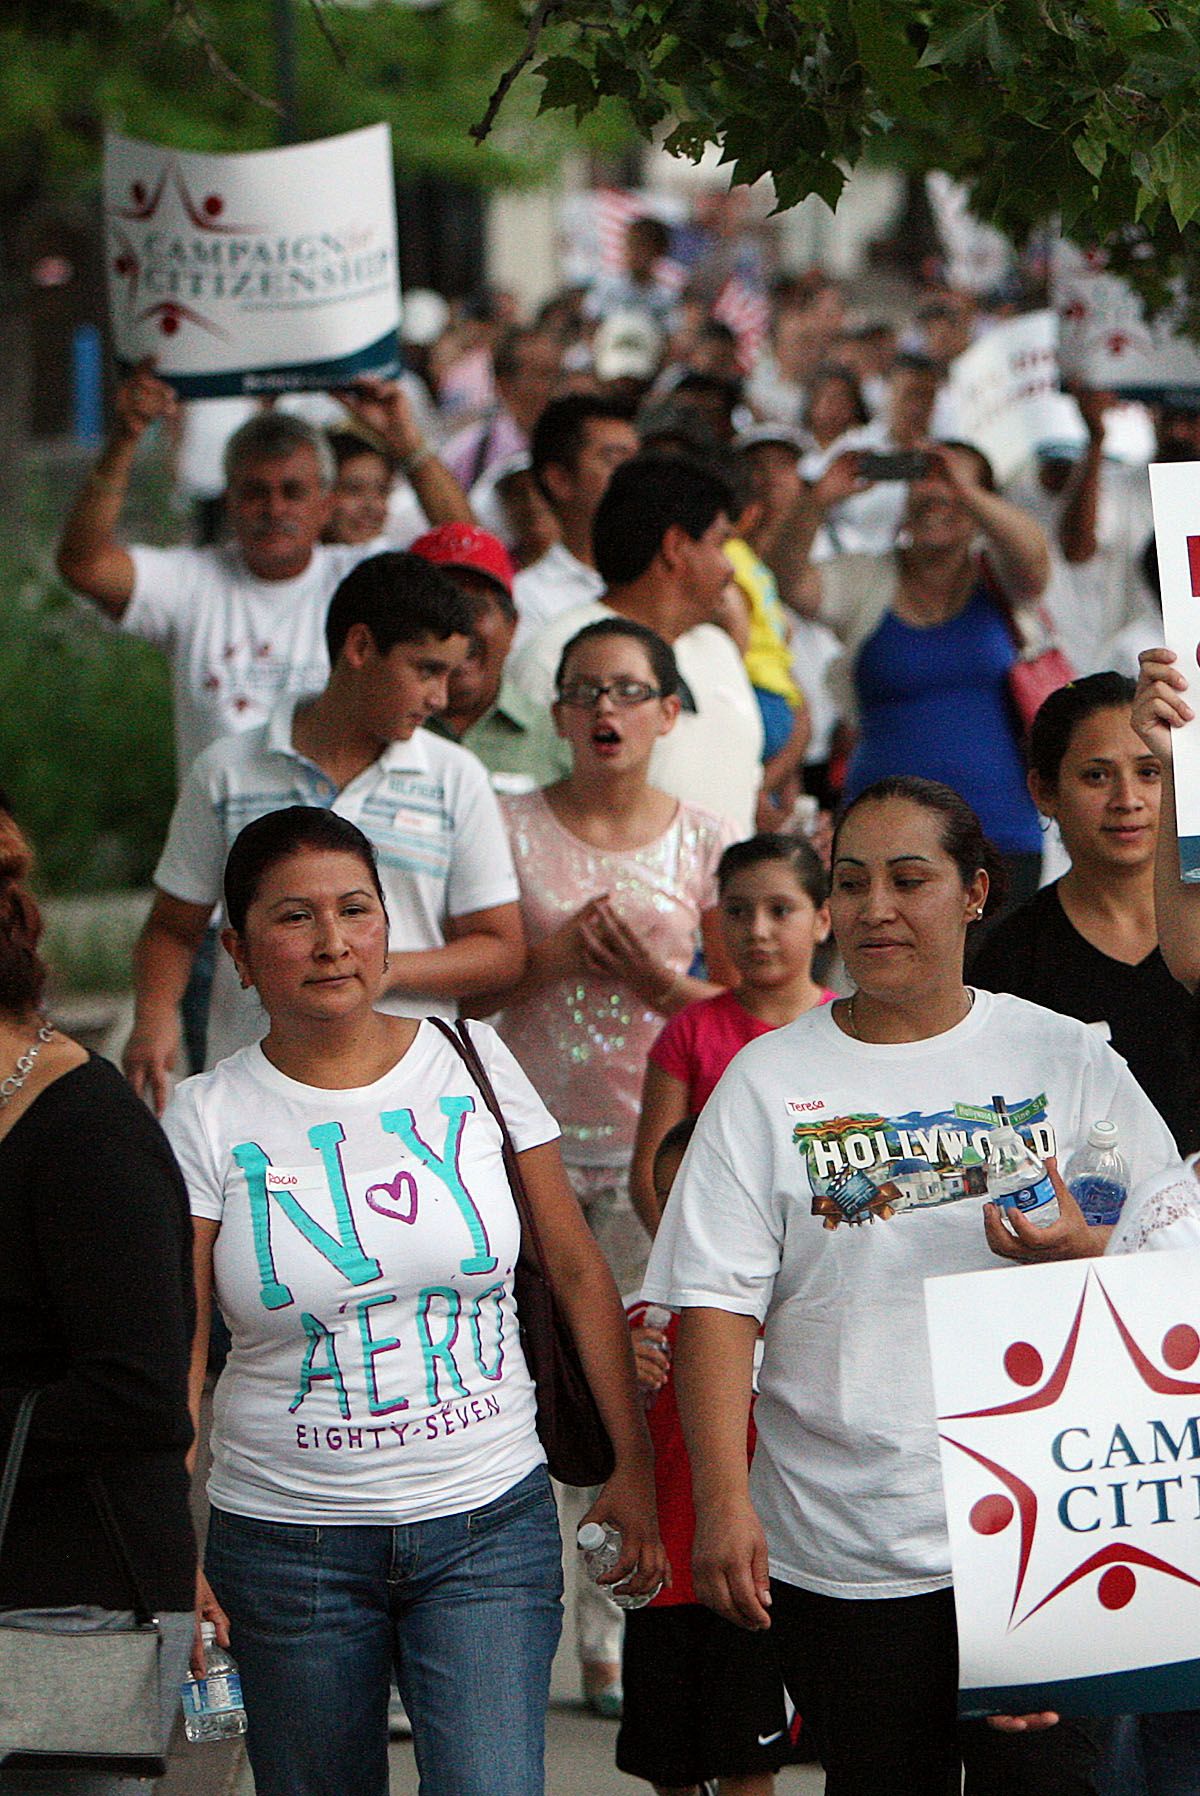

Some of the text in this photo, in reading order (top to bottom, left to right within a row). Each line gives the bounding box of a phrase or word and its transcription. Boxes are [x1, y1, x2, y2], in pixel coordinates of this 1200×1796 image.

[788, 1099, 825, 1113] Teresa
[811, 1121, 1056, 1178] HOLLYWOD
[288, 1281, 507, 1421] AERO
[296, 1393, 501, 1450] EIGHTY-SEVEN
